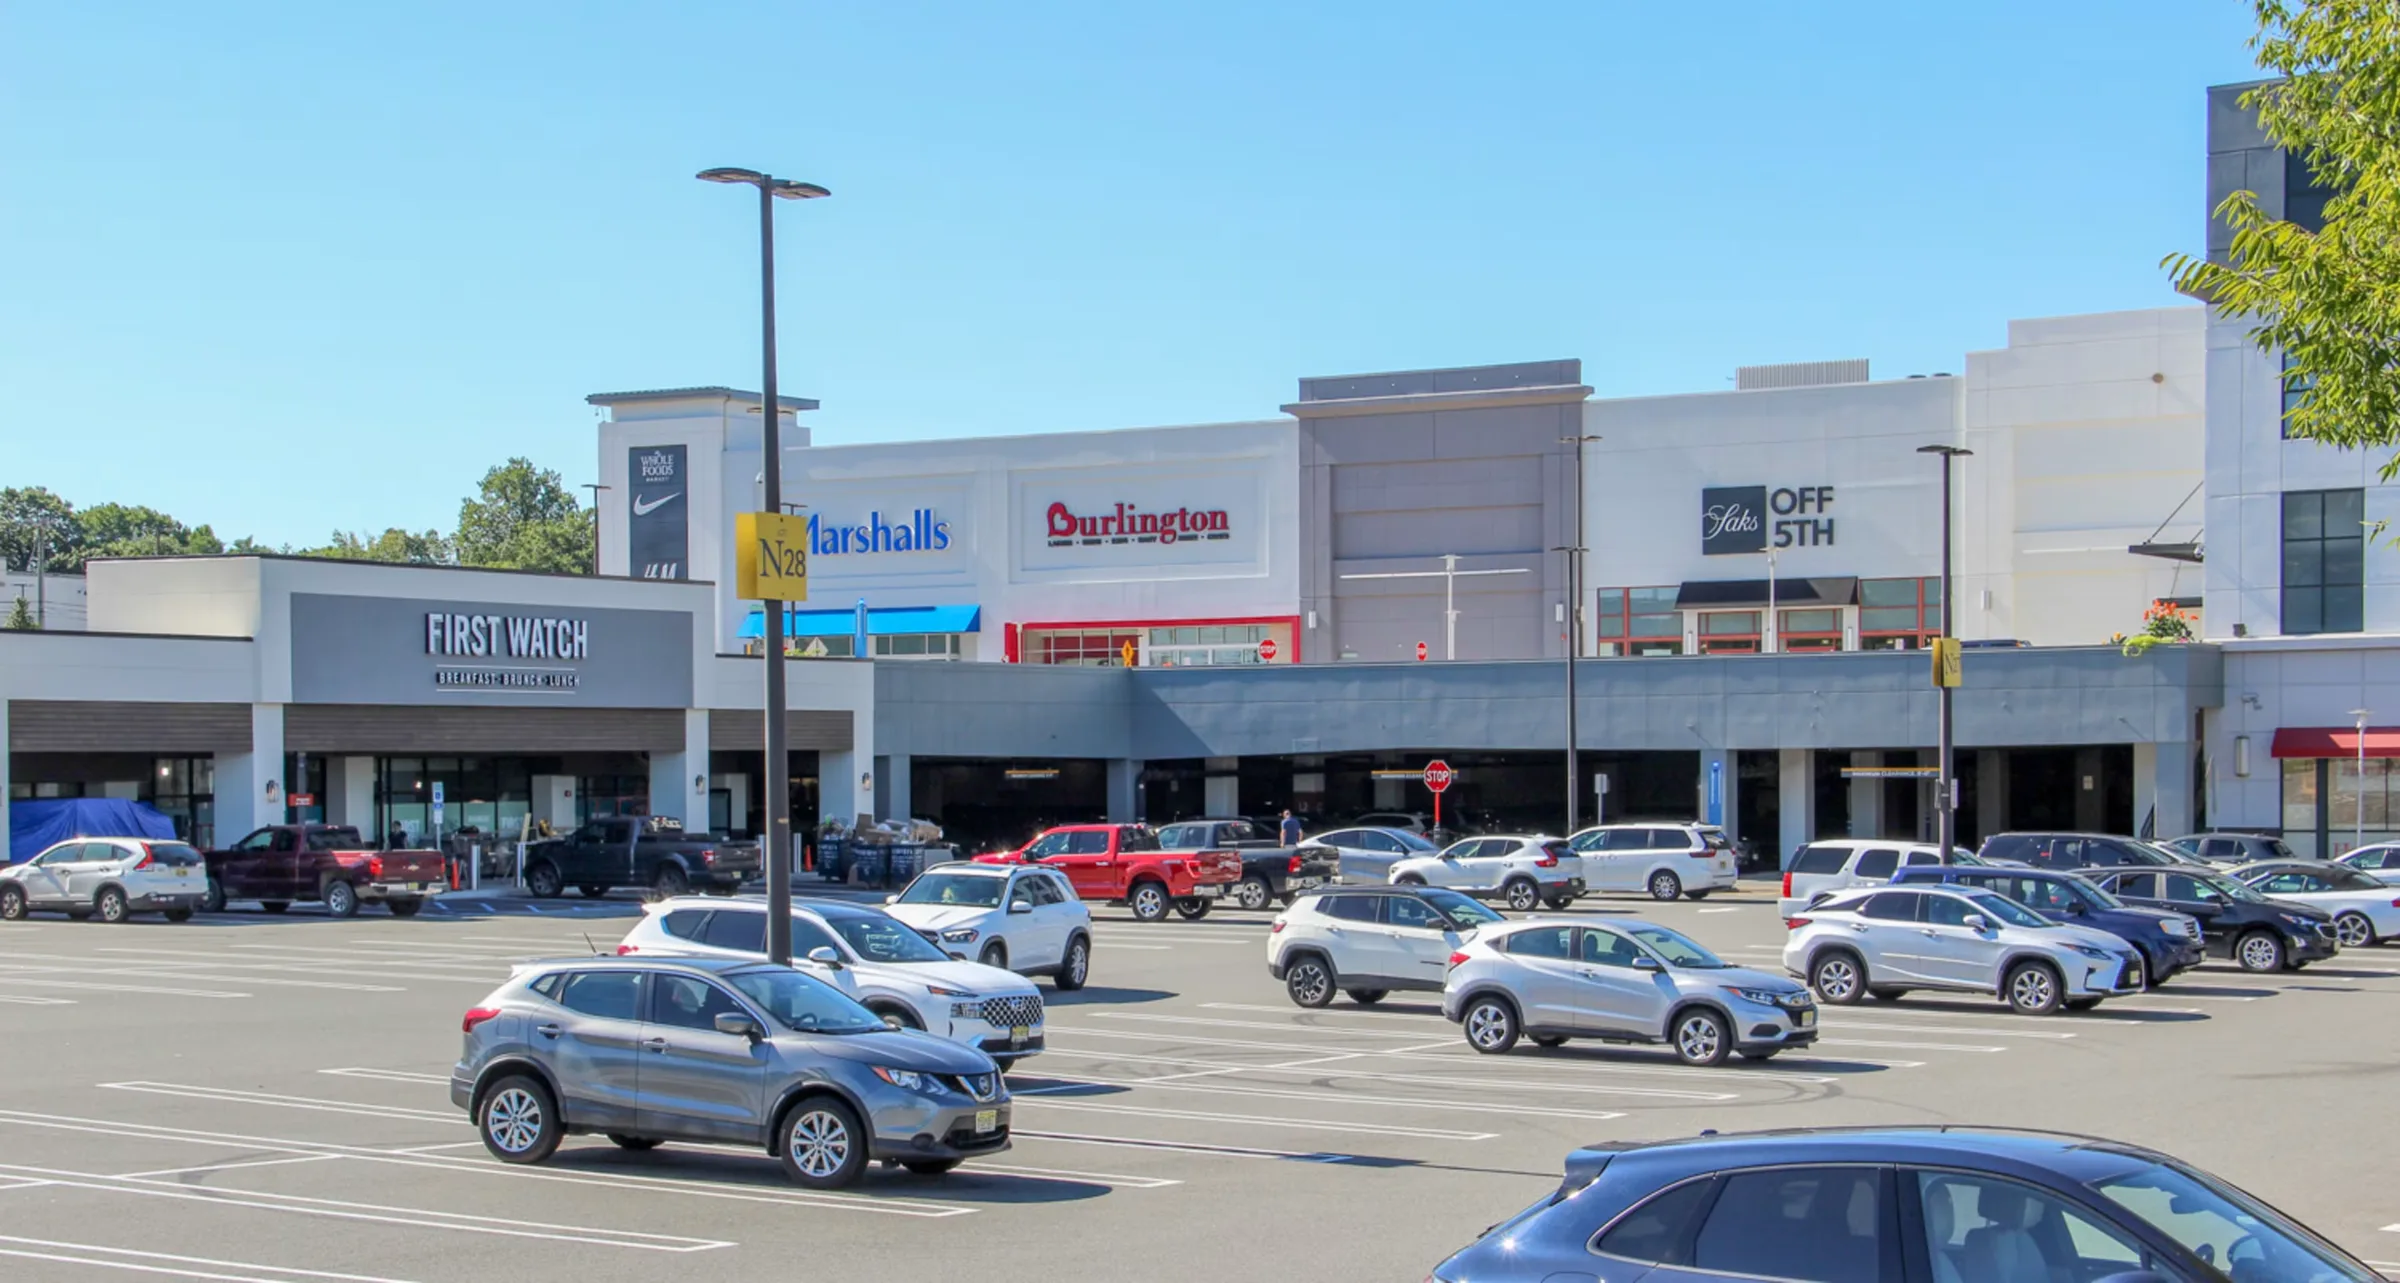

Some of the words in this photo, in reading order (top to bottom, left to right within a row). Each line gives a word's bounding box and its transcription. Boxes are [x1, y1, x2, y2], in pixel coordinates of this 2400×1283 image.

[640, 454, 675, 467] WHOLE
[642, 465, 674, 476] FOODS
[1770, 486, 1834, 515] OFF
[1047, 502, 1230, 544] Burlington
[1702, 503, 1758, 540] Saks
[1773, 518, 1834, 548] 5TH
[425, 613, 500, 656] FIRST
[505, 617, 588, 660] WATCH
[437, 672, 496, 686] BREAKFAST
[502, 673, 542, 687] BRUNCH
[549, 674, 580, 687] LUNCH
[1426, 770, 1449, 782] STOP
